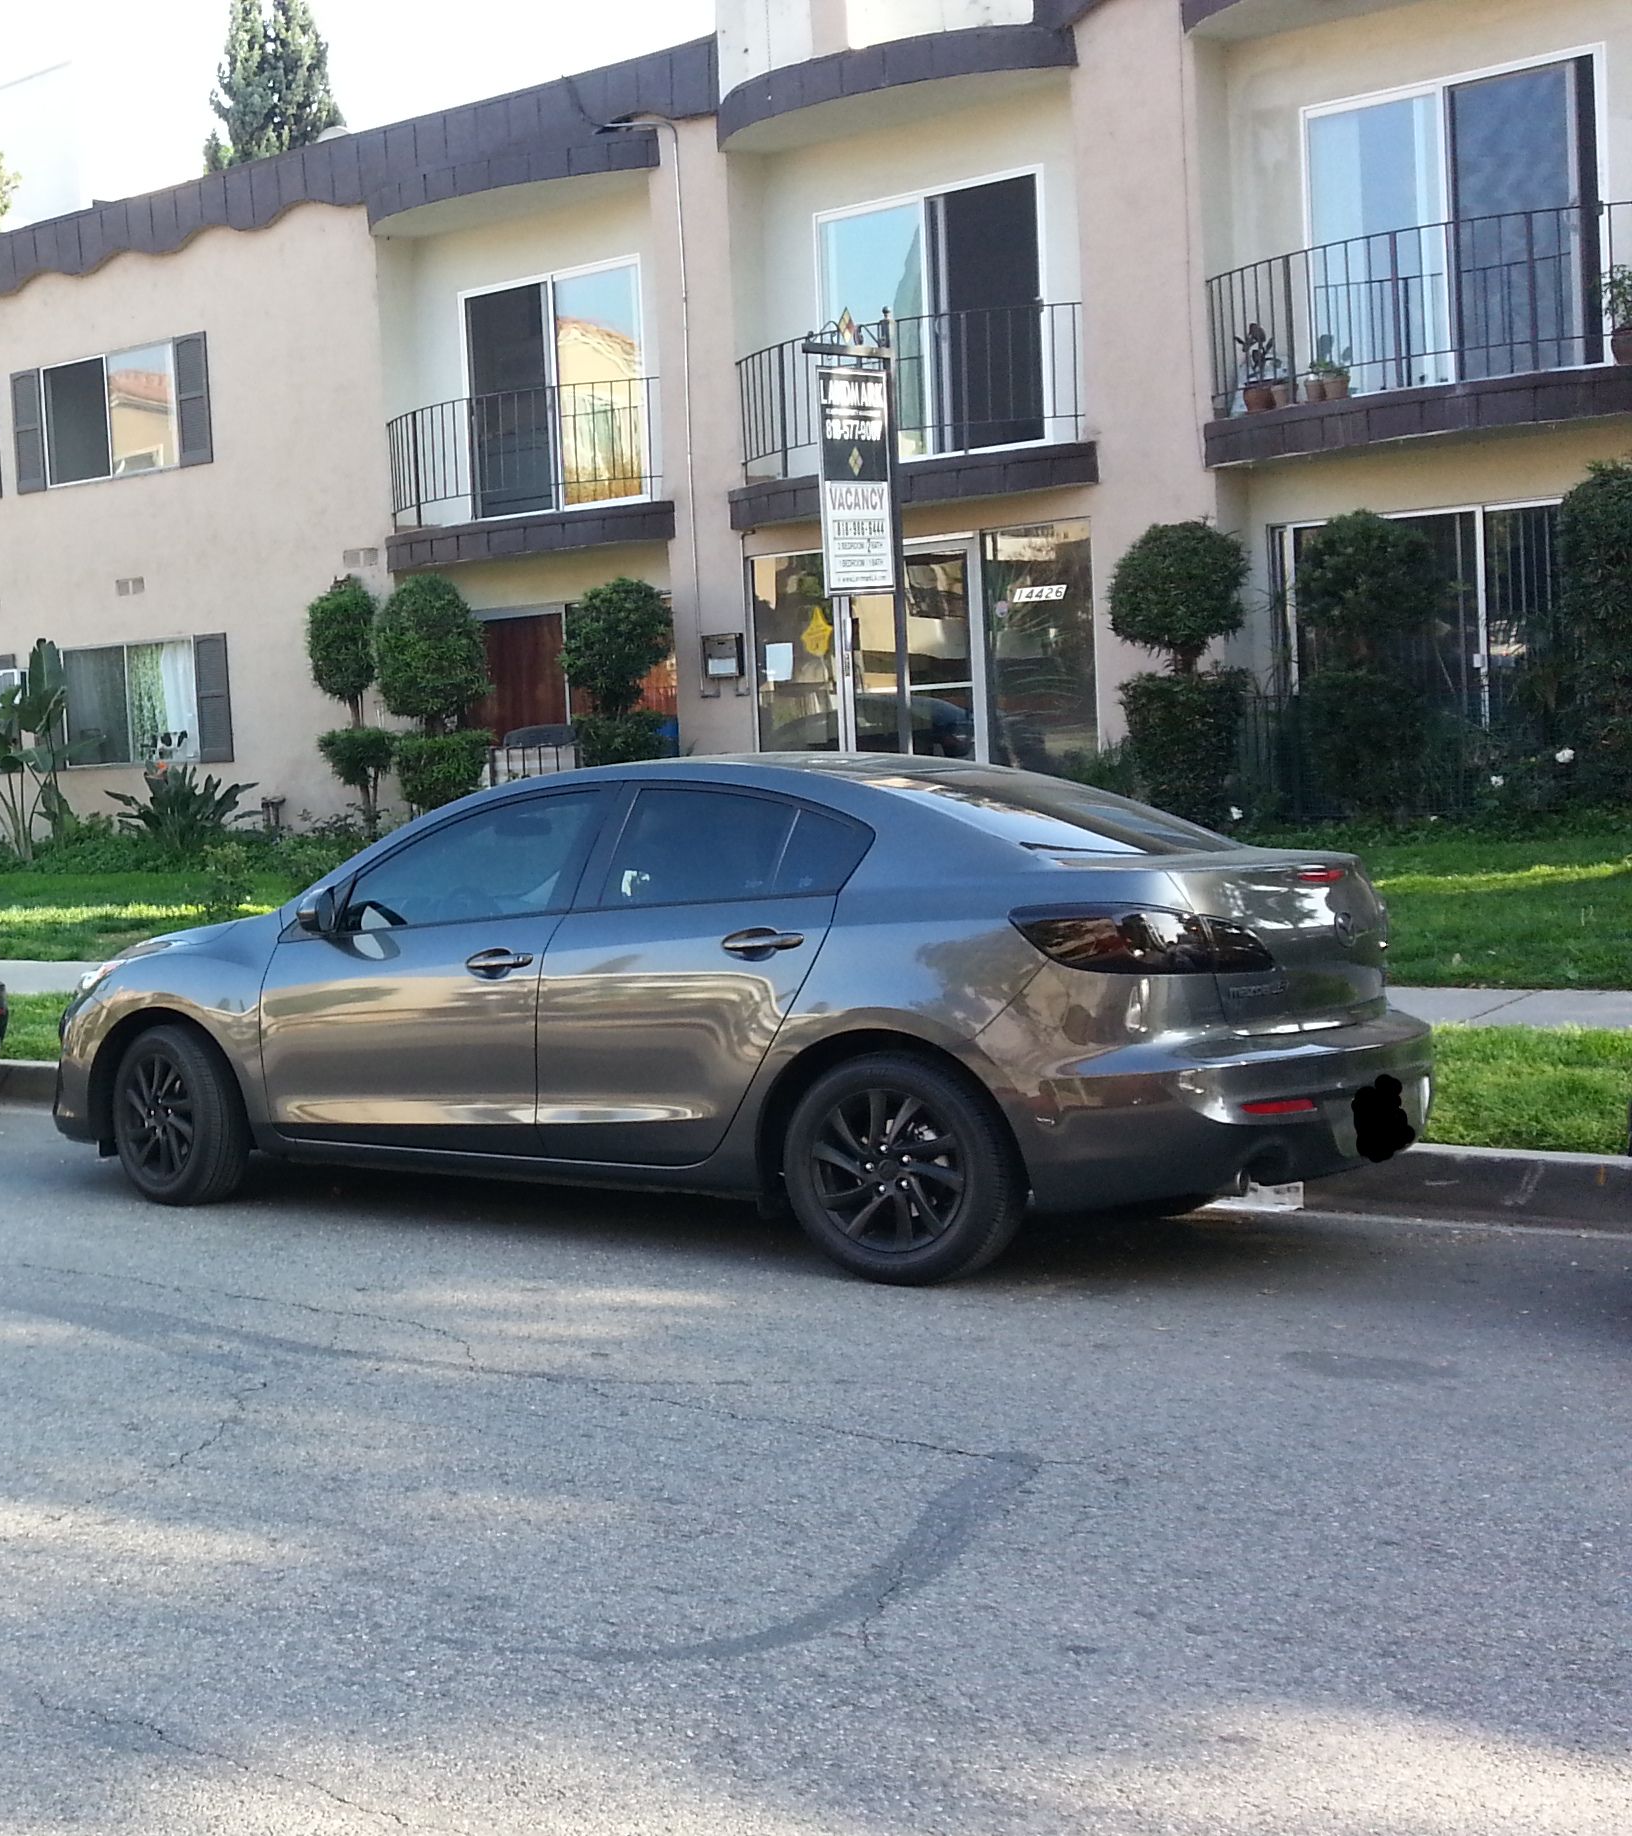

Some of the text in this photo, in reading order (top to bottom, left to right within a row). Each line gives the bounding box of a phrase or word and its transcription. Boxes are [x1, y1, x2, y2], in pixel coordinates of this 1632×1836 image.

[820, 379, 885, 408] LANDMARK
[829, 487, 885, 510] VACANCY
[1018, 586, 1065, 601] 14426
